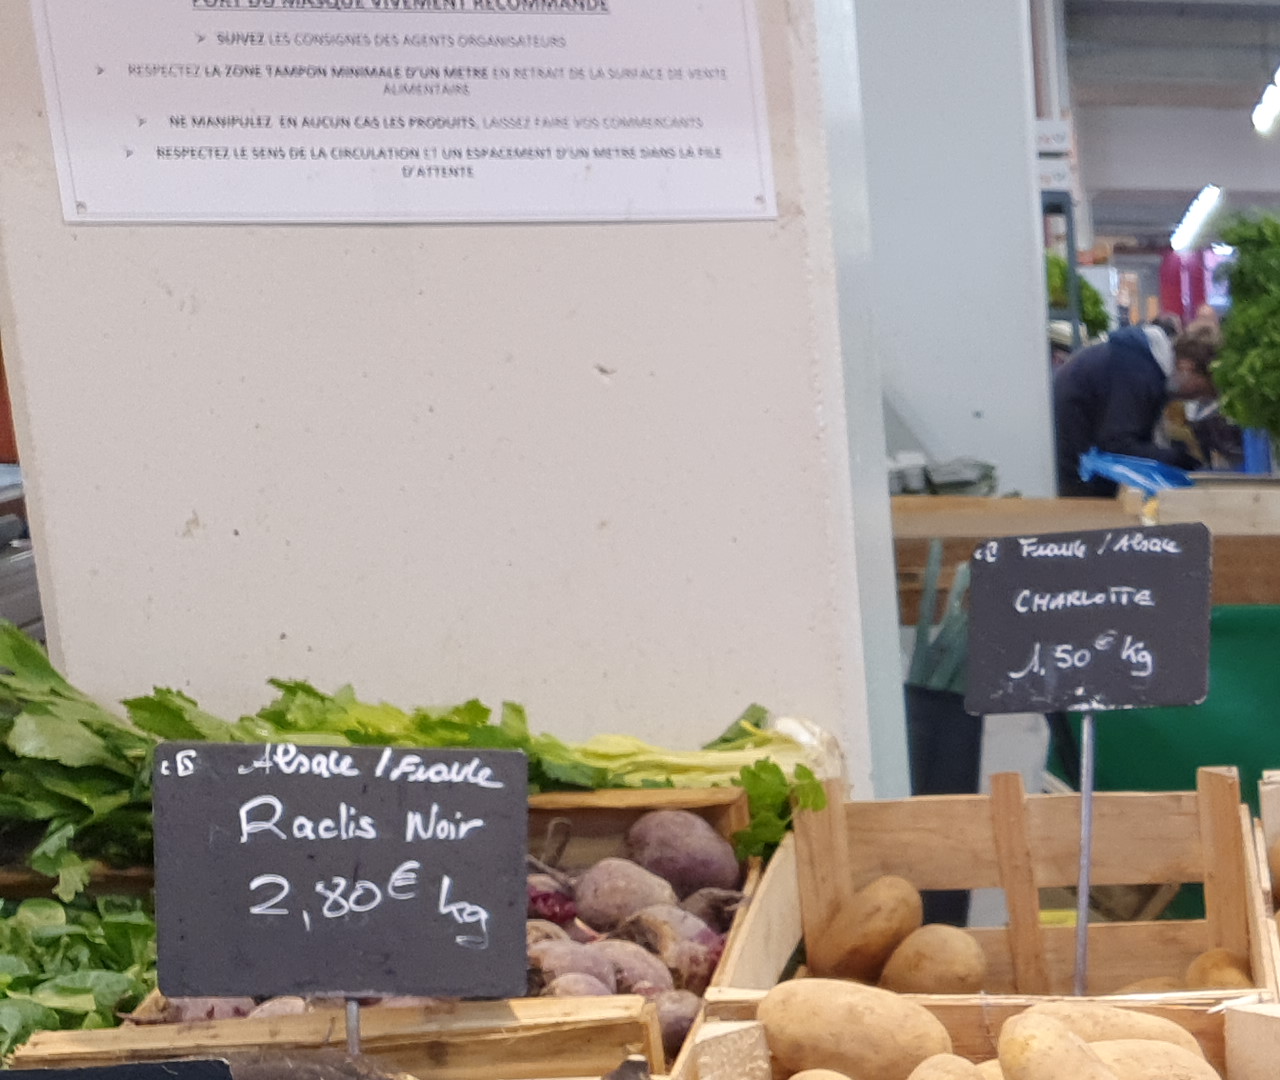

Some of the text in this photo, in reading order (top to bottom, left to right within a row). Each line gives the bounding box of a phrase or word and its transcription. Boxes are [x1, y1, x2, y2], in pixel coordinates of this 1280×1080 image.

[216, 32, 567, 48] SUIVEZ LES CONSIGNES DES AGENTS ORGANISATEURS
[128, 64, 200, 77] RESPECTEZ
[204, 64, 221, 77] LA
[225, 64, 263, 77] ZONE
[266, 64, 327, 78] TAMPON
[331, 65, 402, 78] MINIMALE
[405, 65, 440, 78] D'UN
[492, 66, 509, 79] EN
[513, 66, 564, 79] RETRAIT
[569, 66, 586, 79] DE
[589, 66, 606, 79] LA
[607, 66, 662, 80] SURFACE
[667, 67, 683, 80] DE
[688, 67, 727, 80] VENTE
[383, 84, 470, 96] ALIMENTAIRE
[169, 116, 186, 129] NE
[191, 116, 272, 129] MANIPULEZ
[279, 116, 297, 129] EN
[301, 116, 351, 129] AUCUN
[354, 116, 380, 129] CAS
[383, 116, 405, 129] LES
[482, 116, 531, 129] LAISSEZ
[535, 116, 569, 129] FAIRE
[574, 116, 599, 129] VOS
[156, 147, 229, 160] RESPECTEZ
[233, 147, 248, 160] LE
[252, 147, 286, 160] SENS
[289, 147, 306, 160] DE
[309, 147, 327, 160] LA
[330, 147, 420, 160] CIRCULATION
[422, 147, 437, 160] ET
[441, 146, 462, 159] UN
[466, 146, 551, 159] ESPACEMENT
[556, 146, 589, 159] D'UN
[640, 146, 676, 159] DANS
[678, 146, 694, 159] LA
[698, 146, 721, 159] FILE
[401, 165, 474, 178] D'ATTENTE
[1014, 586, 1156, 613] CHARLOTTE
[404, 801, 486, 843] Noir
